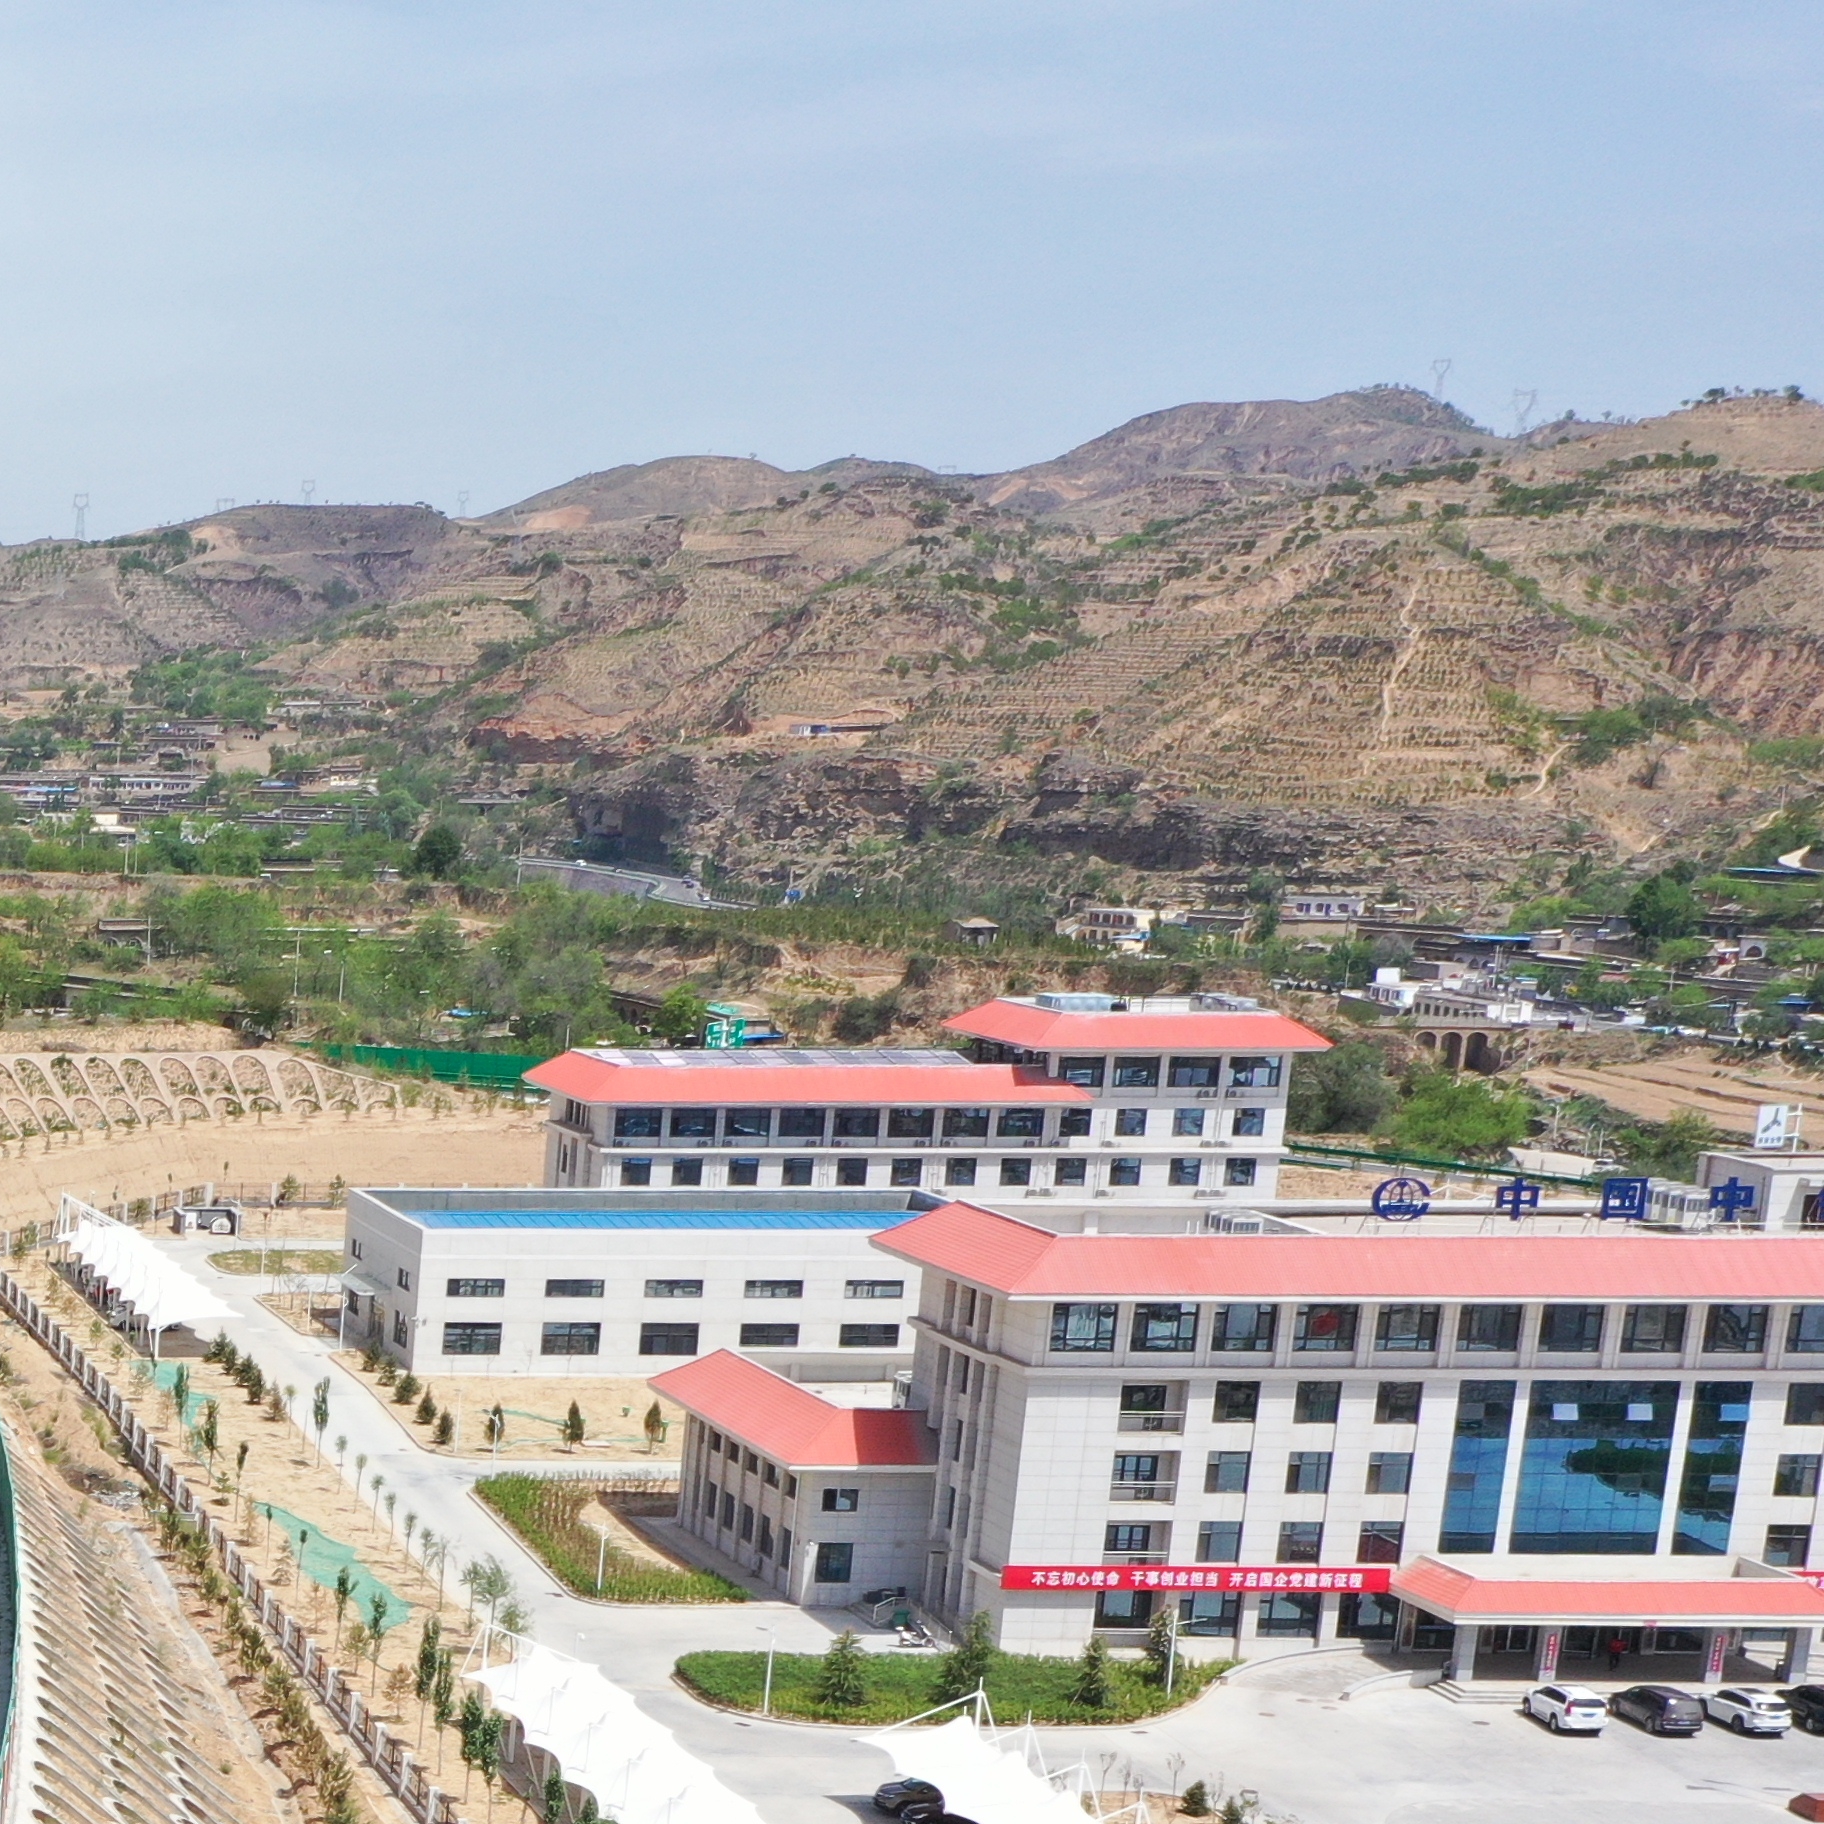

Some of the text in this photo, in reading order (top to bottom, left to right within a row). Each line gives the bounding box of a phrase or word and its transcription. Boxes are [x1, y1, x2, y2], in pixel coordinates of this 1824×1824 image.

[1496, 1177, 1824, 1222] 中国中
[1031, 1571, 1363, 1588] 不忘初心使命 干事创业担当 开启国企党建新征程
